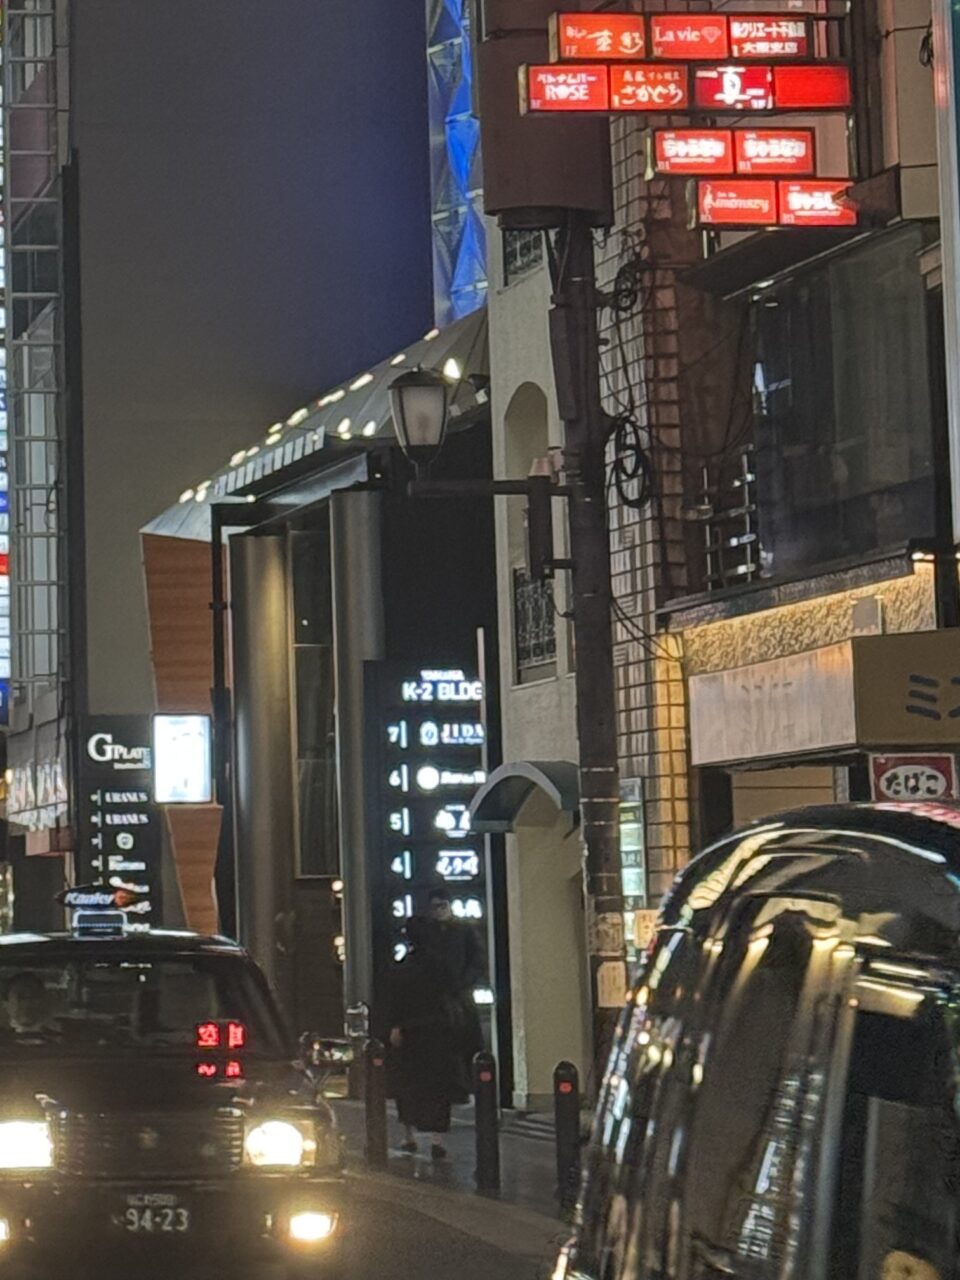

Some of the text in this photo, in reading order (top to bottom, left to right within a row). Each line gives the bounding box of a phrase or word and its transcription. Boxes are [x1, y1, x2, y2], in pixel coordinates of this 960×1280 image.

[402, 681, 434, 701] K-2
[906, 673, 960, 721] ミ
[884, 772, 939, 796] たばこ
[390, 813, 402, 829] 5
